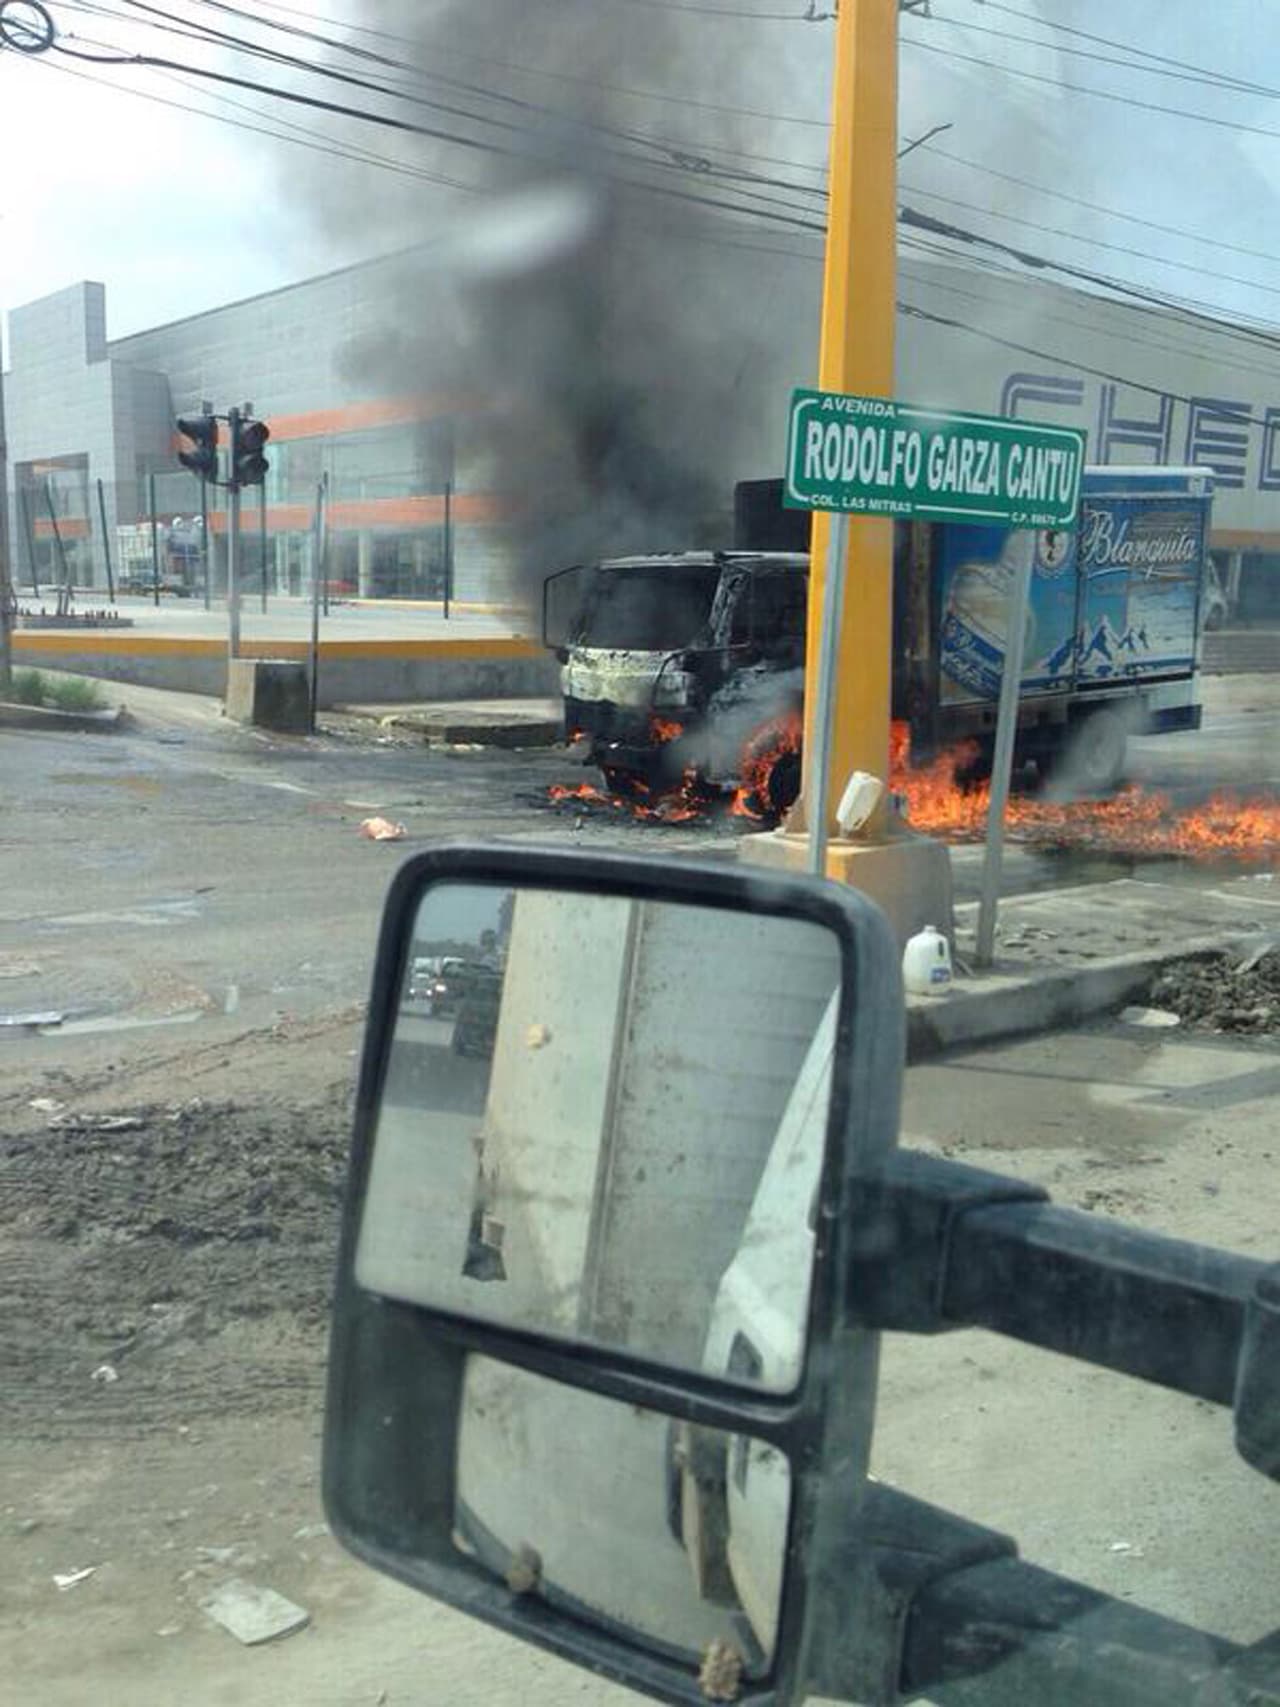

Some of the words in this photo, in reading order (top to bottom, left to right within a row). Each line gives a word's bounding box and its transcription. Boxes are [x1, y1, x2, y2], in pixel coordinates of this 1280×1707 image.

[821, 398, 896, 418] AVENIDA
[804, 420, 921, 489] RODOLFO
[927, 435, 1000, 496] GARZA
[1006, 444, 1075, 503] CANTU
[811, 494, 840, 507] COL.
[842, 496, 866, 509] LAS
[868, 498, 912, 513] MITRAS
[1083, 509, 1196, 580] Blanquita
